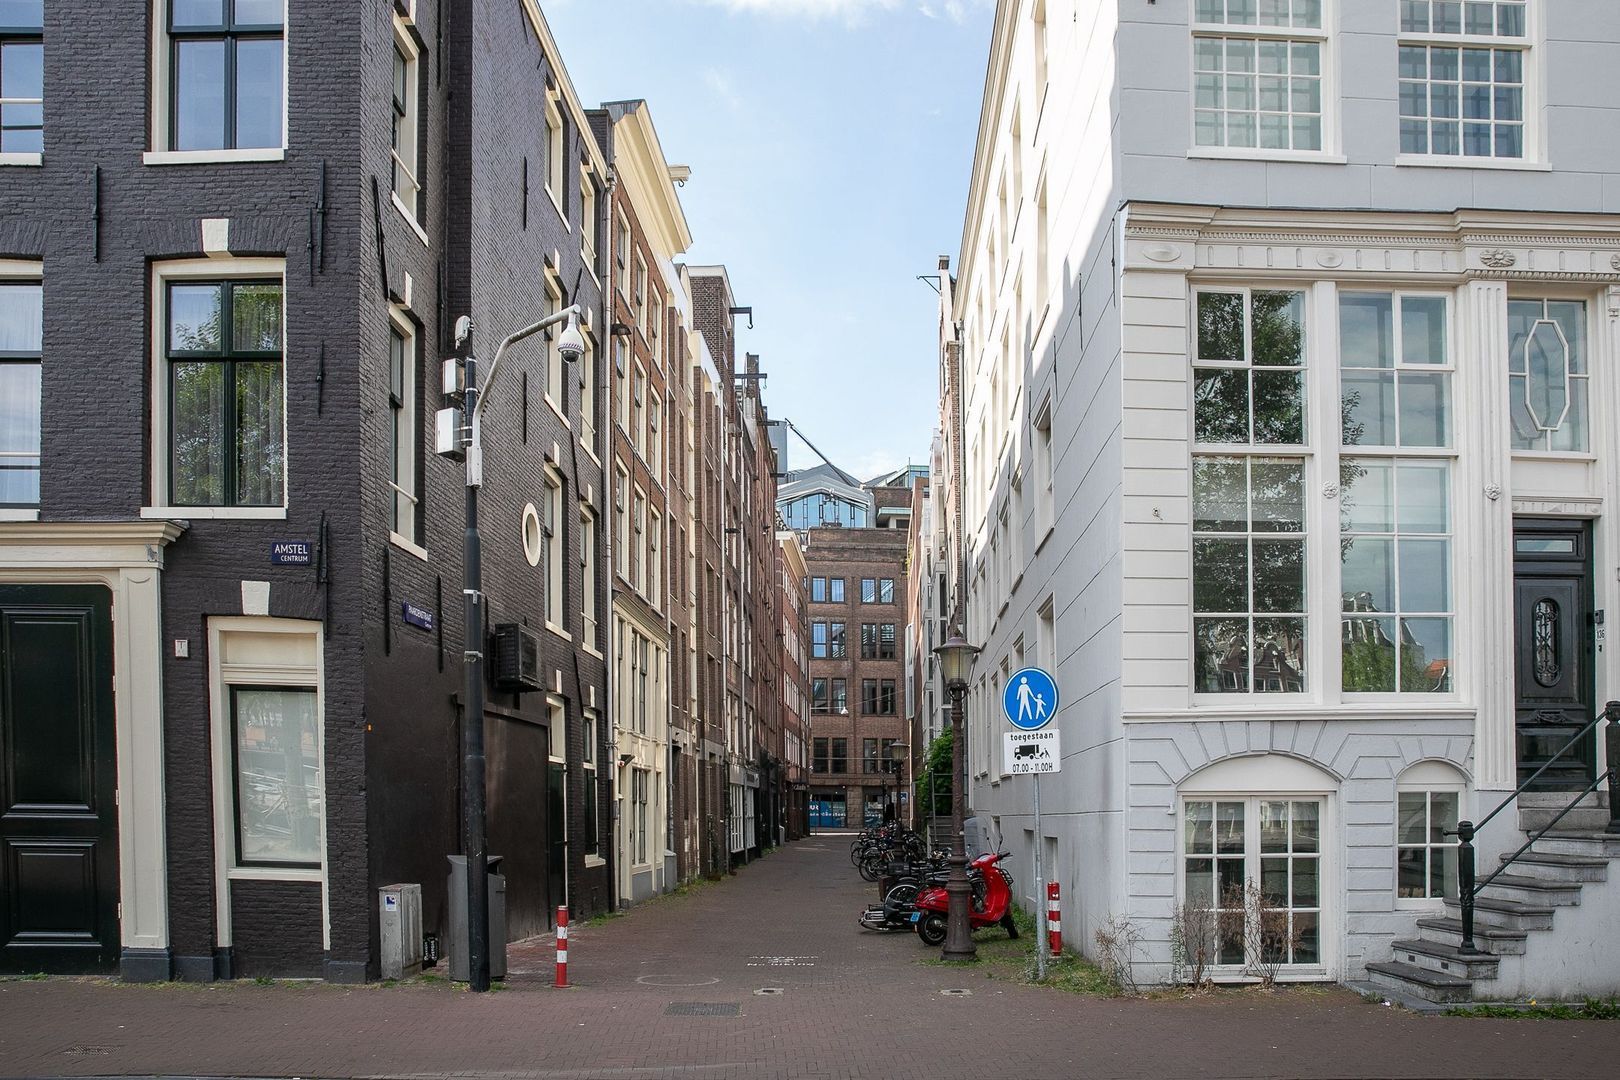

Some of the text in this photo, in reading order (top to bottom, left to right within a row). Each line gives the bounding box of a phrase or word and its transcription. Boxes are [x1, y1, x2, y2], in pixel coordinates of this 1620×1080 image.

[274, 544, 308, 554] AMSTEL
[1010, 732, 1054, 742] toegestaan
[1012, 763, 1030, 773] 07.00
